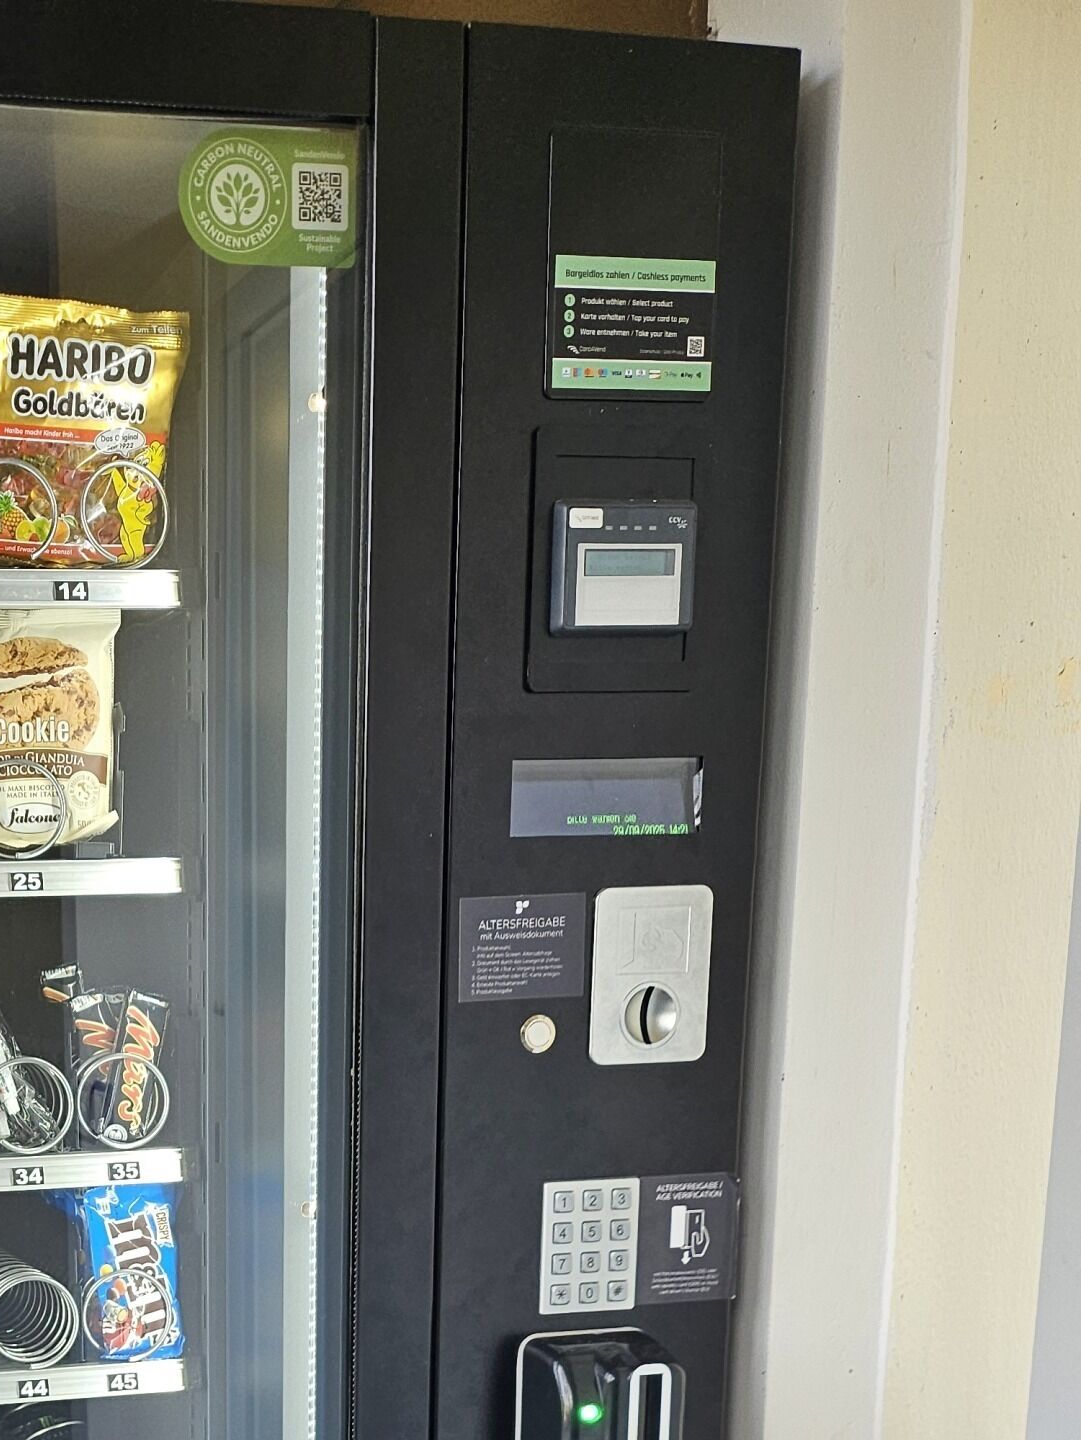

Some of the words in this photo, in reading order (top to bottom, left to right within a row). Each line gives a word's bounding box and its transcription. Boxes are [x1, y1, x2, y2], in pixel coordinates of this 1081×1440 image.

[194, 142, 234, 188] CARBON
[237, 143, 283, 193] NEUTRAL
[197, 210, 279, 248] SANDENVENDO
[565, 269, 604, 279] Bargeldlos
[606, 271, 630, 279] zahlen
[637, 272, 669, 281] Cashless
[670, 273, 707, 283] payments
[581, 297, 604, 305] Produkt
[651, 300, 673, 308] product
[631, 315, 642, 323] Tap
[131, 325, 150, 334] Zum
[152, 324, 184, 335] Teilen
[580, 328, 596, 336] Ware
[635, 330, 648, 338] Take
[650, 331, 663, 339] your
[10, 336, 153, 385] HARIBO
[12, 389, 145, 422] Goldbären
[100, 434, 113, 442] Das
[668, 516, 682, 524] CCV
[58, 583, 87, 600] 14
[24, 751, 85, 768] GIANDUIA
[7, 785, 26, 793] MAXI
[6, 807, 61, 828] falcone
[13, 873, 42, 890] 25
[478, 916, 566, 930] ALTERSFREIGABE
[480, 932, 493, 940] mit
[494, 930, 564, 940] Ausweisdokument
[117, 1005, 162, 1122] Mars
[15, 1168, 43, 1184] 34
[112, 1163, 139, 1179] 35
[561, 1197, 567, 1208] 1
[589, 1196, 597, 1207] 2
[618, 1193, 625, 1205] 3
[655, 1192, 671, 1200] AGE
[156, 1211, 171, 1241] CRISPY
[558, 1228, 566, 1239] 4
[588, 1227, 596, 1238] 5
[616, 1224, 624, 1236] 6
[558, 1259, 566, 1269] 7
[587, 1257, 594, 1268] 8
[615, 1254, 623, 1266] 9
[586, 1288, 593, 1299] 0
[20, 1380, 48, 1396] 44
[110, 1374, 137, 1390] 45
